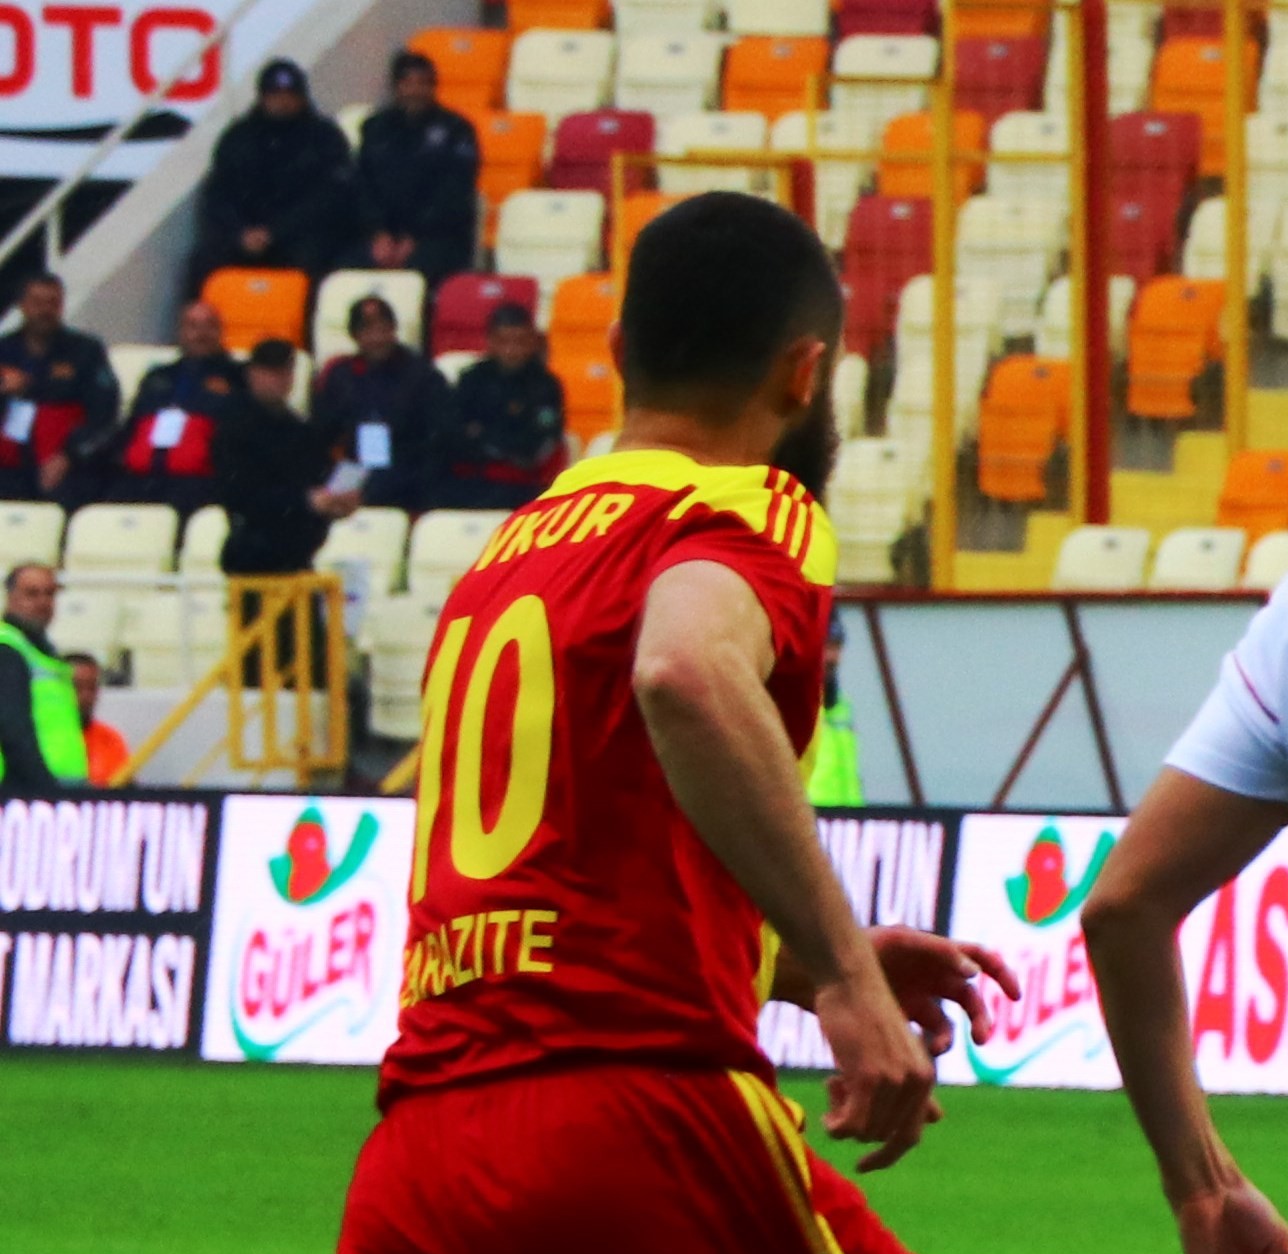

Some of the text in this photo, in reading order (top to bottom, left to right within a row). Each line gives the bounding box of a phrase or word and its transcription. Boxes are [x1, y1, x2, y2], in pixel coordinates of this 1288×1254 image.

[415, 594, 556, 906] 10
[8, 932, 197, 1049] MARKASI
[241, 902, 375, 1018] GÜLER
